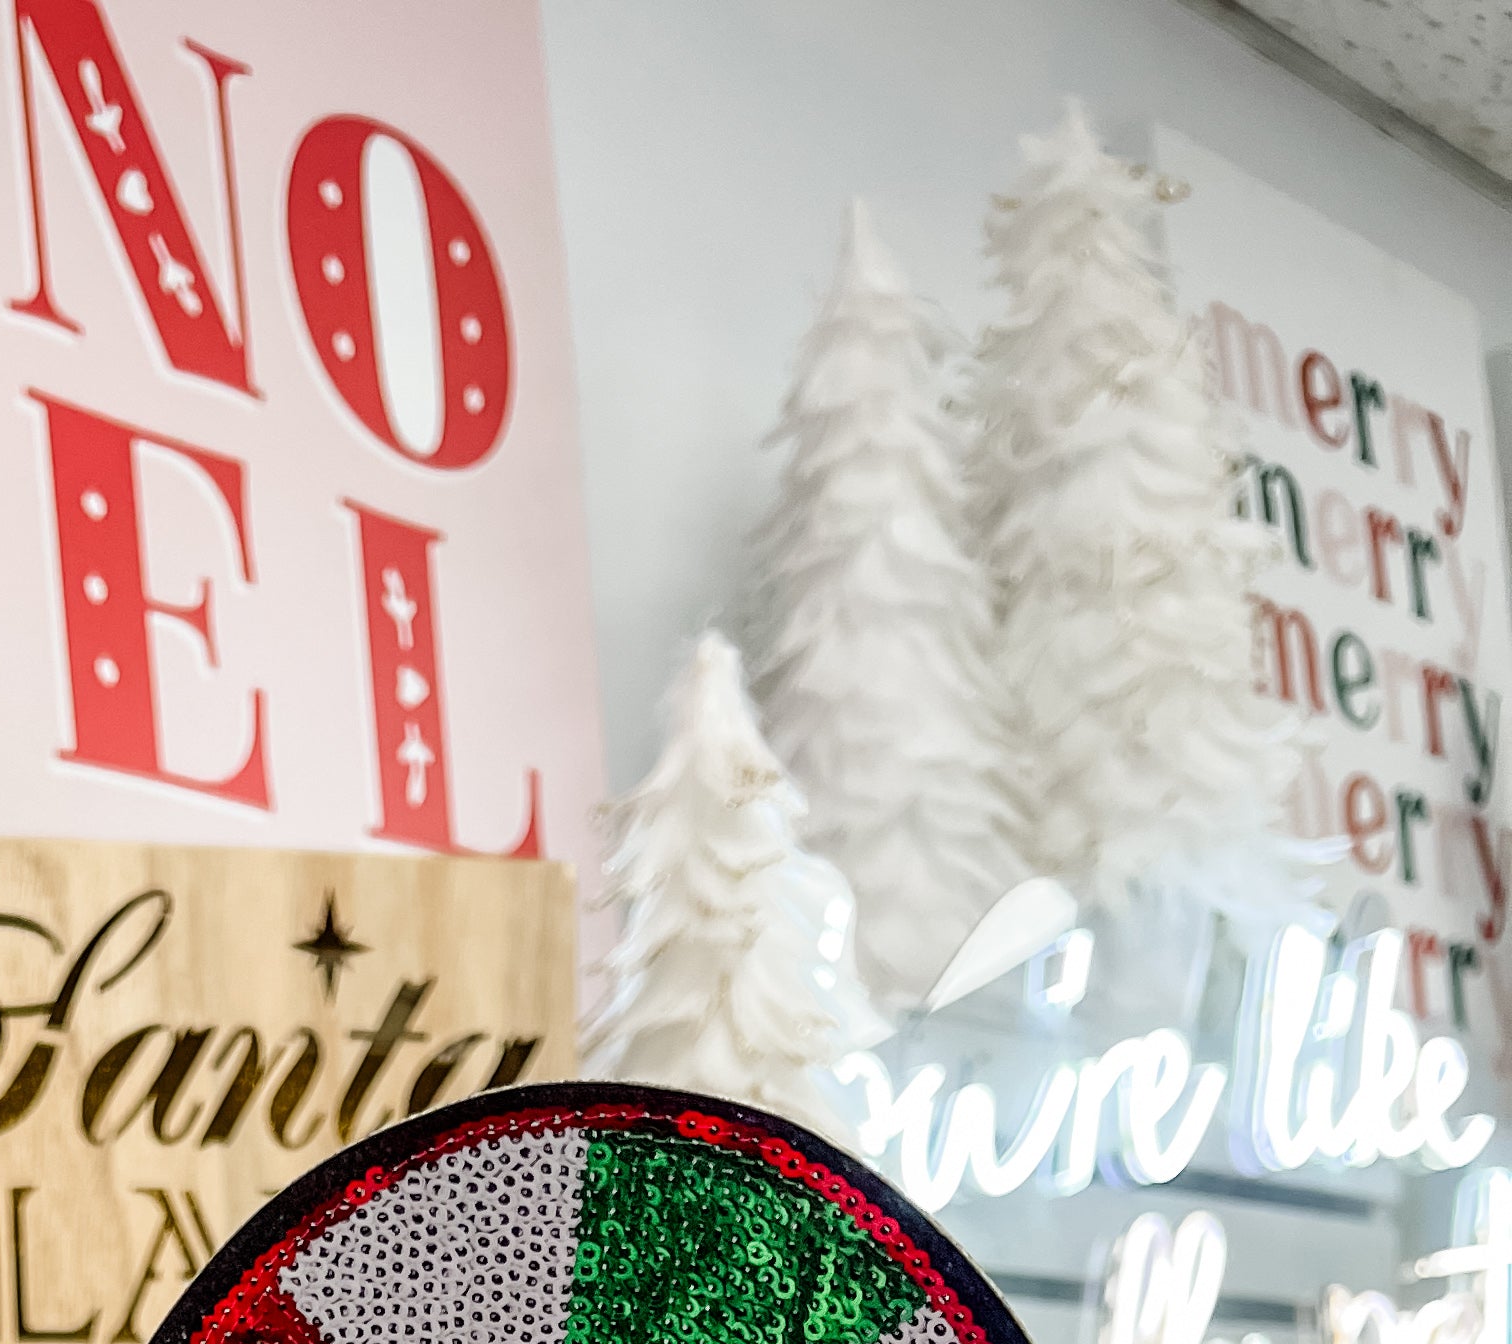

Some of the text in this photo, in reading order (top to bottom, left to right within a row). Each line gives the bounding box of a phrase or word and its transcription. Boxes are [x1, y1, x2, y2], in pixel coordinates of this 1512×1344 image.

[1194, 300, 1470, 538] merry
[1230, 452, 1487, 676] merry
[1244, 592, 1500, 806] merry
[1252, 922, 1497, 1172] like
